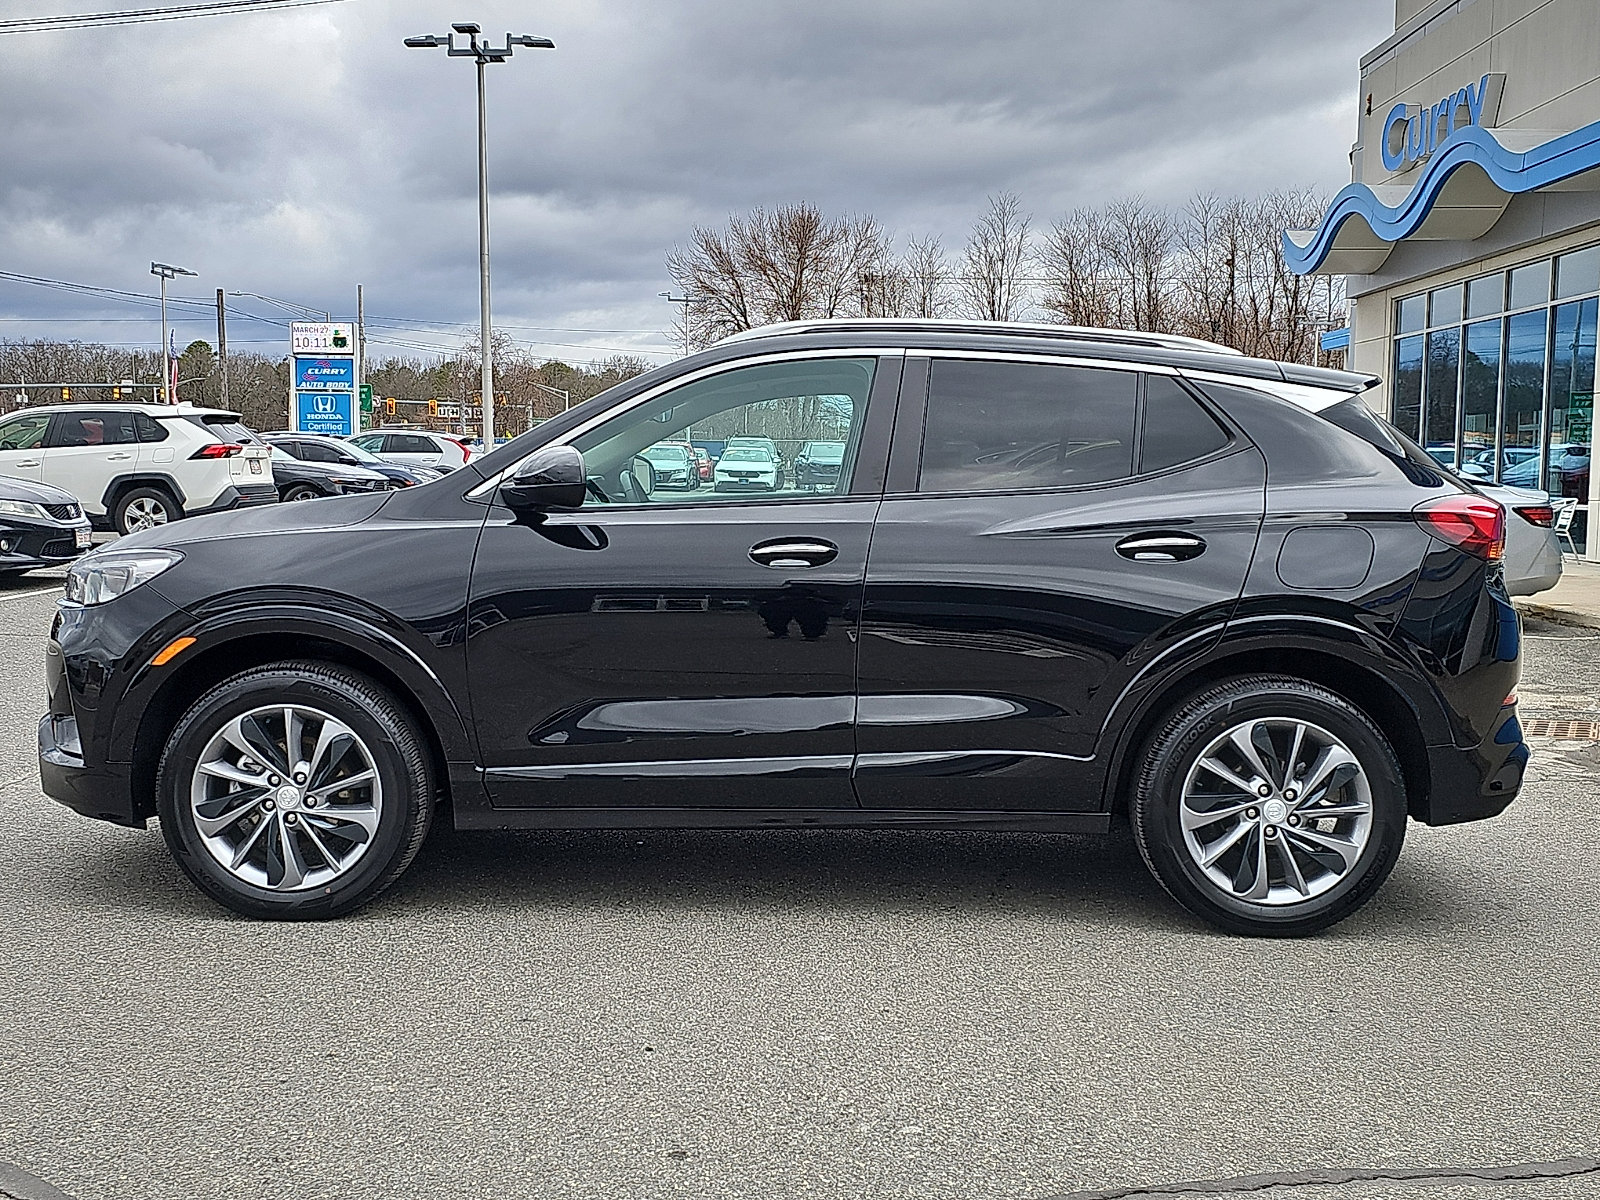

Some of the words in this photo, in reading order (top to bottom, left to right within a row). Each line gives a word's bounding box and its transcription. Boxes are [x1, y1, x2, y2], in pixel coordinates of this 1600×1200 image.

[1381, 73, 1492, 172] Curry
[293, 326, 319, 334] MARCH
[294, 337, 329, 348] 10:11
[308, 422, 343, 431] Certified
